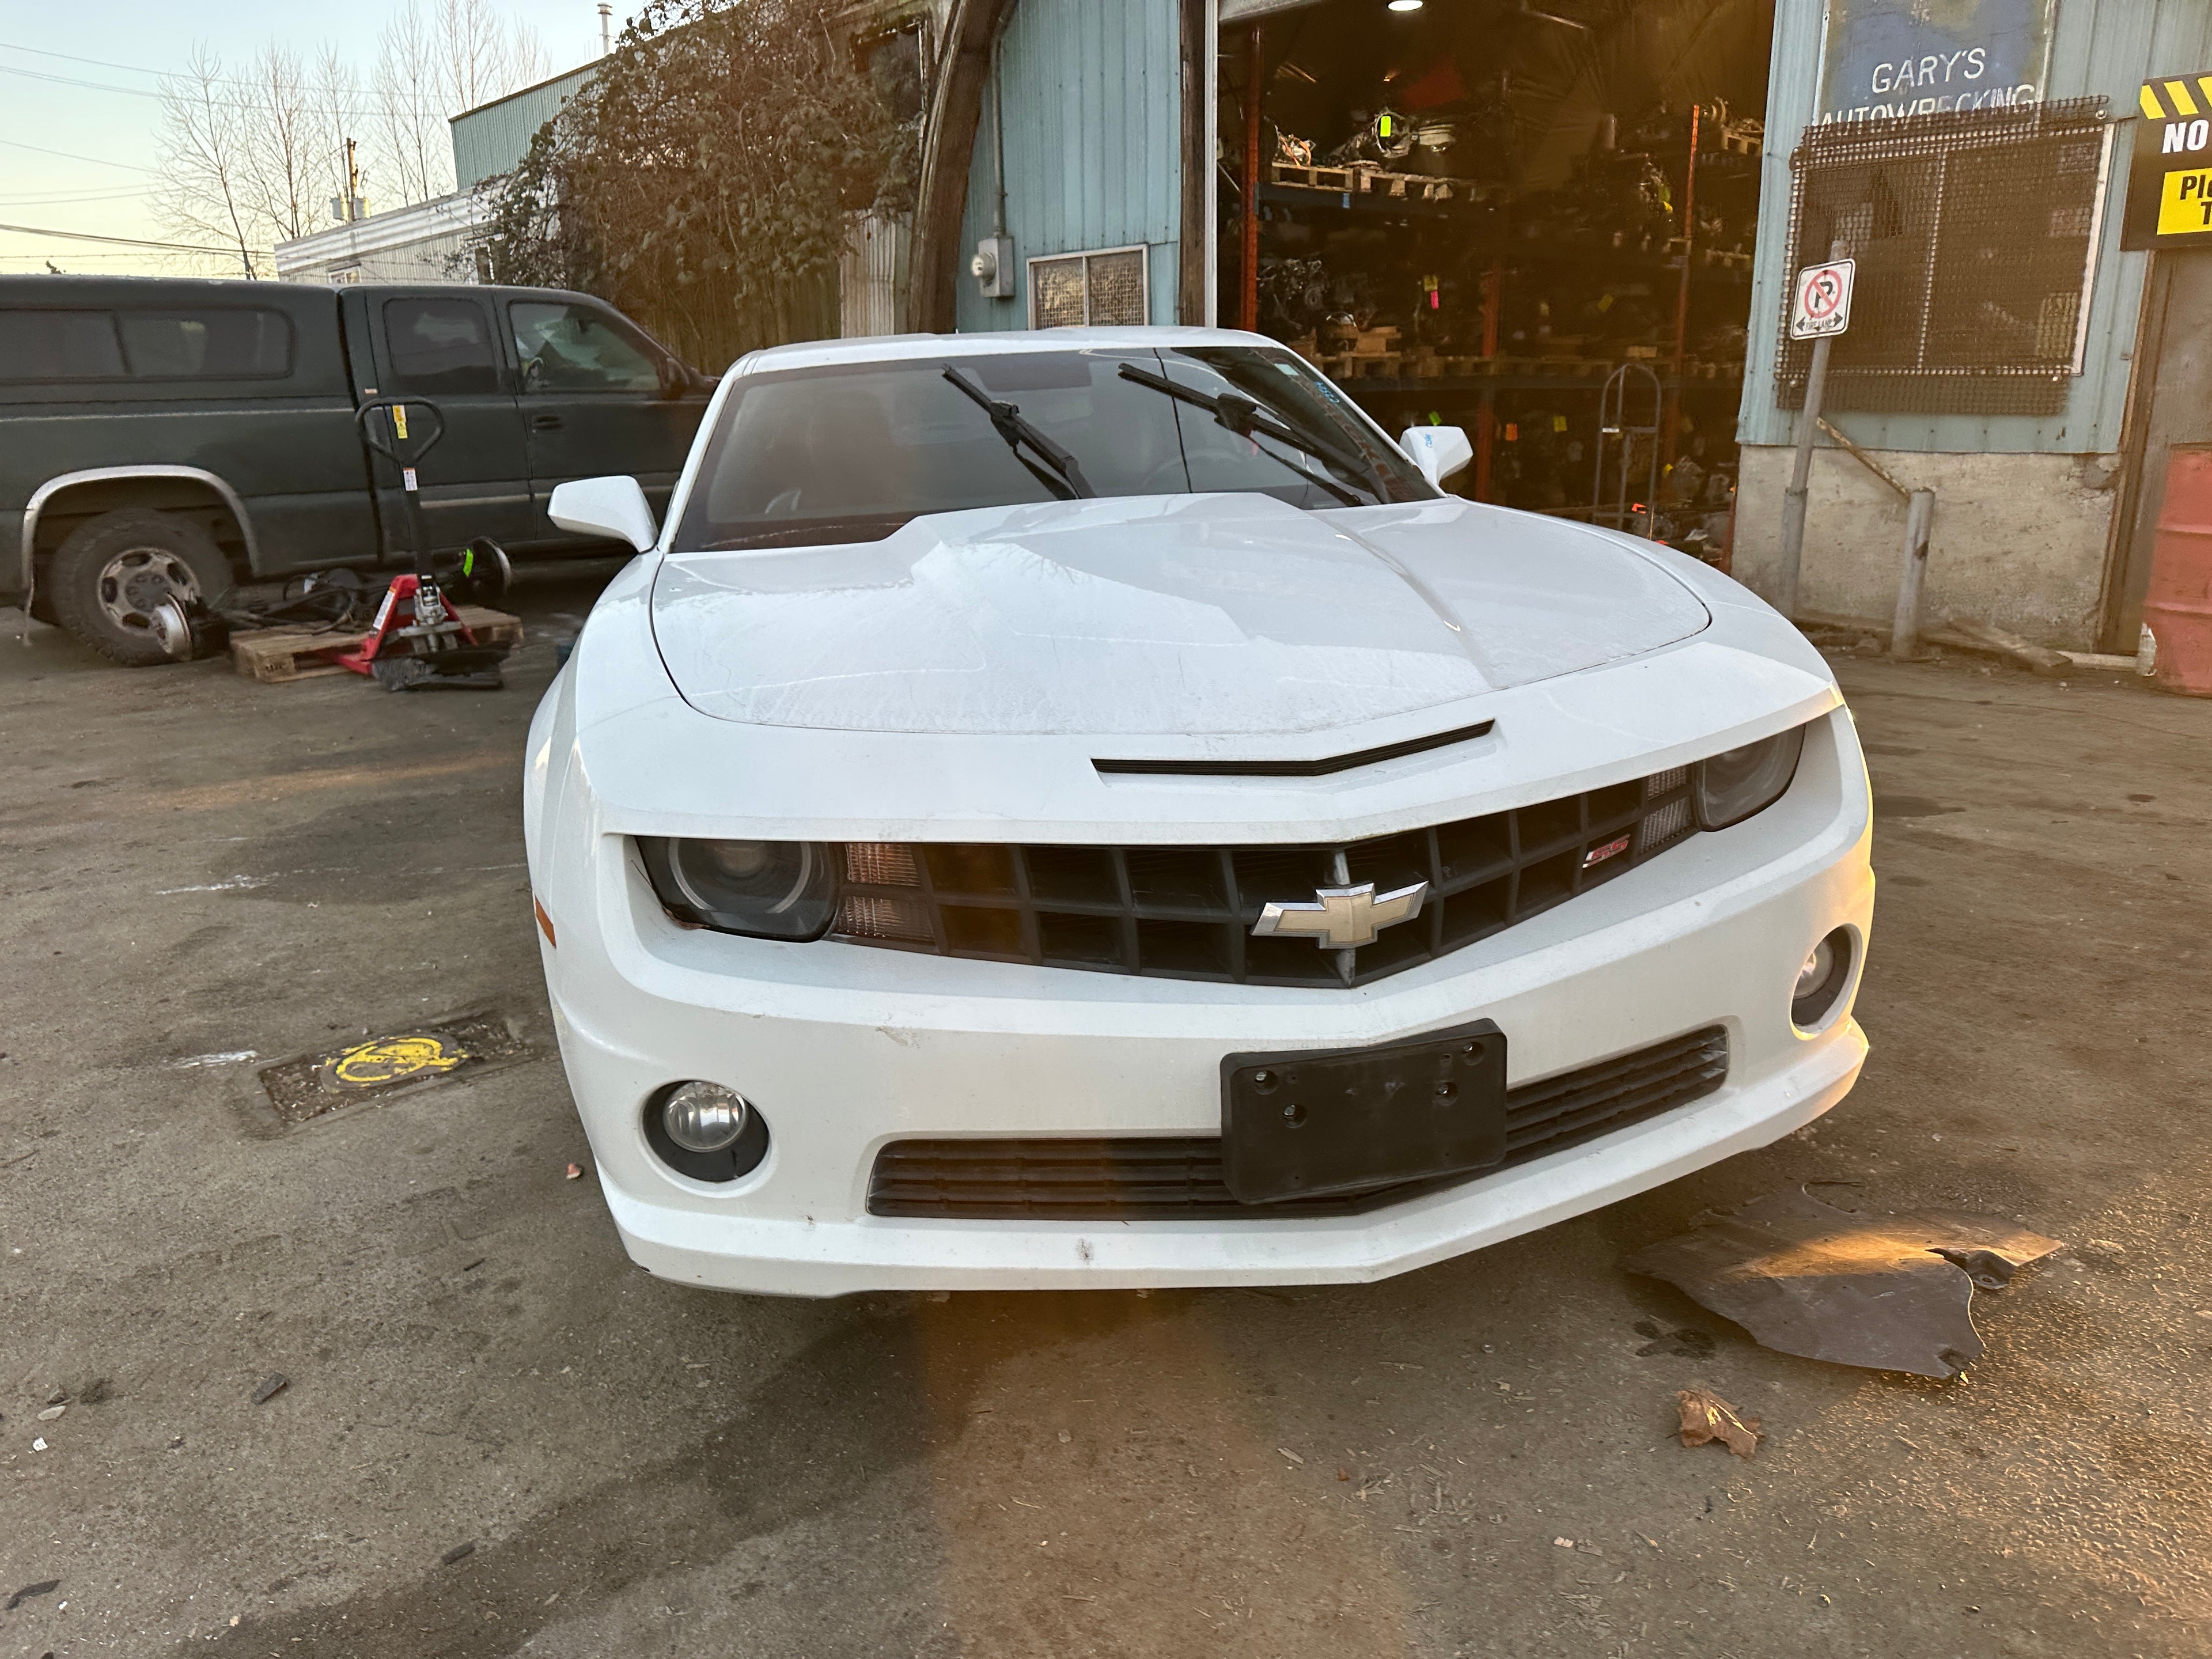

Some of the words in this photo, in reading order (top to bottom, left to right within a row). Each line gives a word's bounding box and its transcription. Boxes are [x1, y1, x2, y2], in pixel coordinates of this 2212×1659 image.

[1872, 47, 1986, 94] GARY'S
[2161, 119, 2210, 154] NO
[1582, 834, 1630, 869] SS
